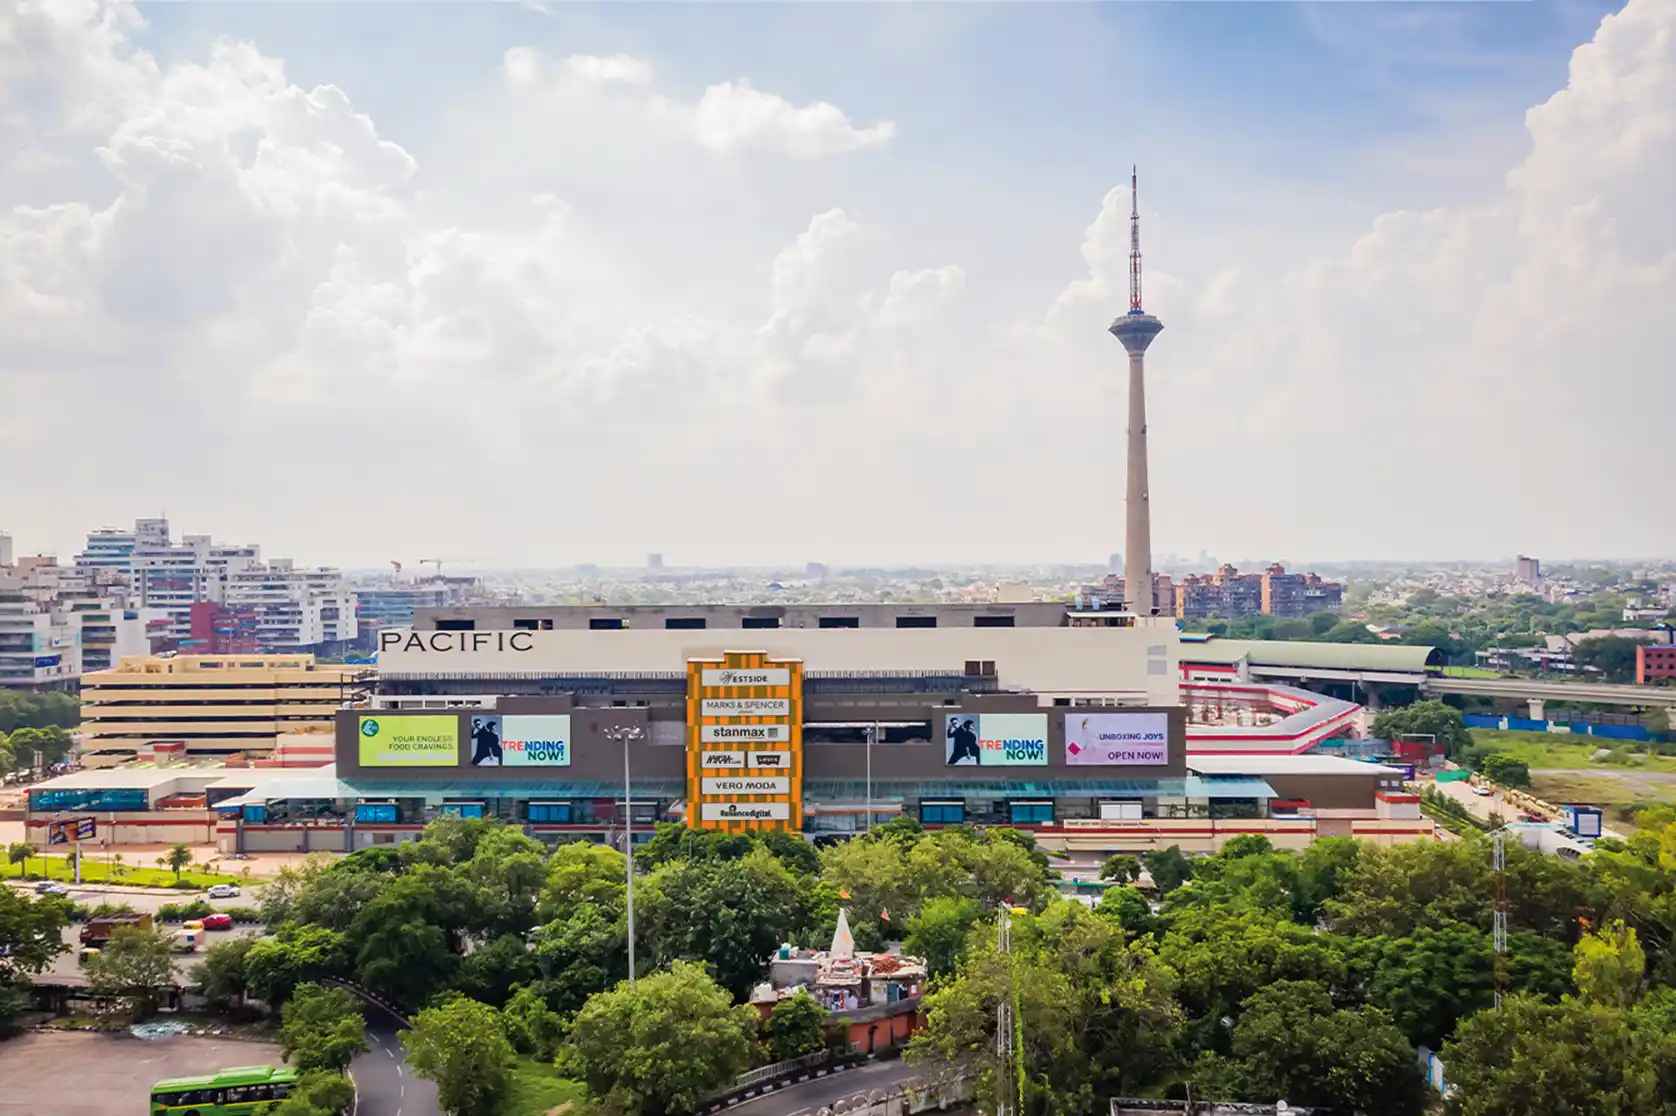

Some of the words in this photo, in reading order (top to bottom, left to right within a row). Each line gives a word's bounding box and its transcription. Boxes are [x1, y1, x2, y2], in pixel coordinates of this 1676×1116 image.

[381, 631, 533, 652] PACIFIC
[707, 701, 735, 709] MARKS
[737, 701, 742, 709] &
[744, 701, 784, 709] SPENCER
[713, 727, 765, 737] stanmax
[1099, 733, 1141, 741] UNBOXING
[1143, 733, 1164, 741] JOYS
[389, 743, 410, 751] FOOD
[502, 740, 564, 751] TRENDING
[979, 740, 1044, 750] TRENDING
[528, 751, 564, 760] NOW!
[1006, 750, 1044, 760] NOW!
[1108, 751, 1135, 760] OPEN
[1136, 751, 1164, 760] NOW!
[716, 781, 742, 789] VERO
[745, 781, 776, 789] MODA
